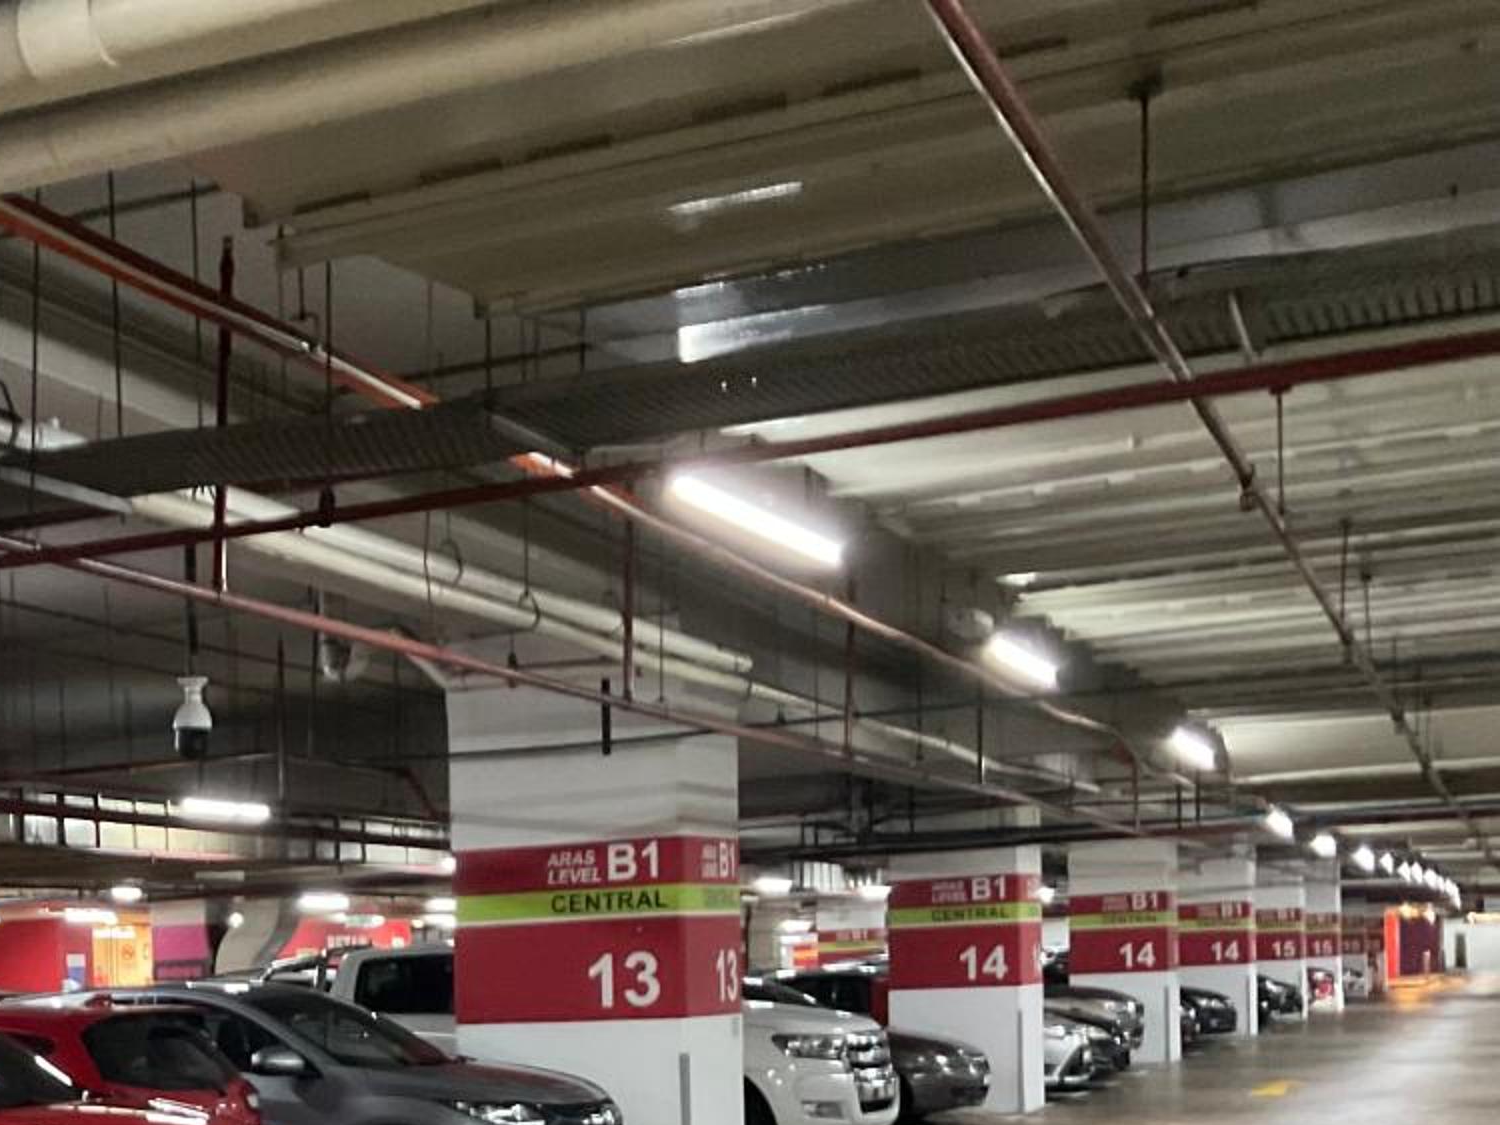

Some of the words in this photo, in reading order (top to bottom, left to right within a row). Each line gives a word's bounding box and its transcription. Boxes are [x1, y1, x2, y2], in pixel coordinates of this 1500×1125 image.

[547, 849, 596, 867] ARAS
[607, 840, 659, 881] B1
[547, 866, 602, 885] LEVEL
[971, 876, 1006, 900] B1
[550, 888, 669, 914] CENTRAL
[1119, 942, 1157, 969] 14
[1211, 940, 1240, 962] 14
[1272, 941, 1296, 957] 15
[715, 949, 738, 1002] 13
[959, 944, 1009, 981] 14
[588, 951, 661, 1009] 13
